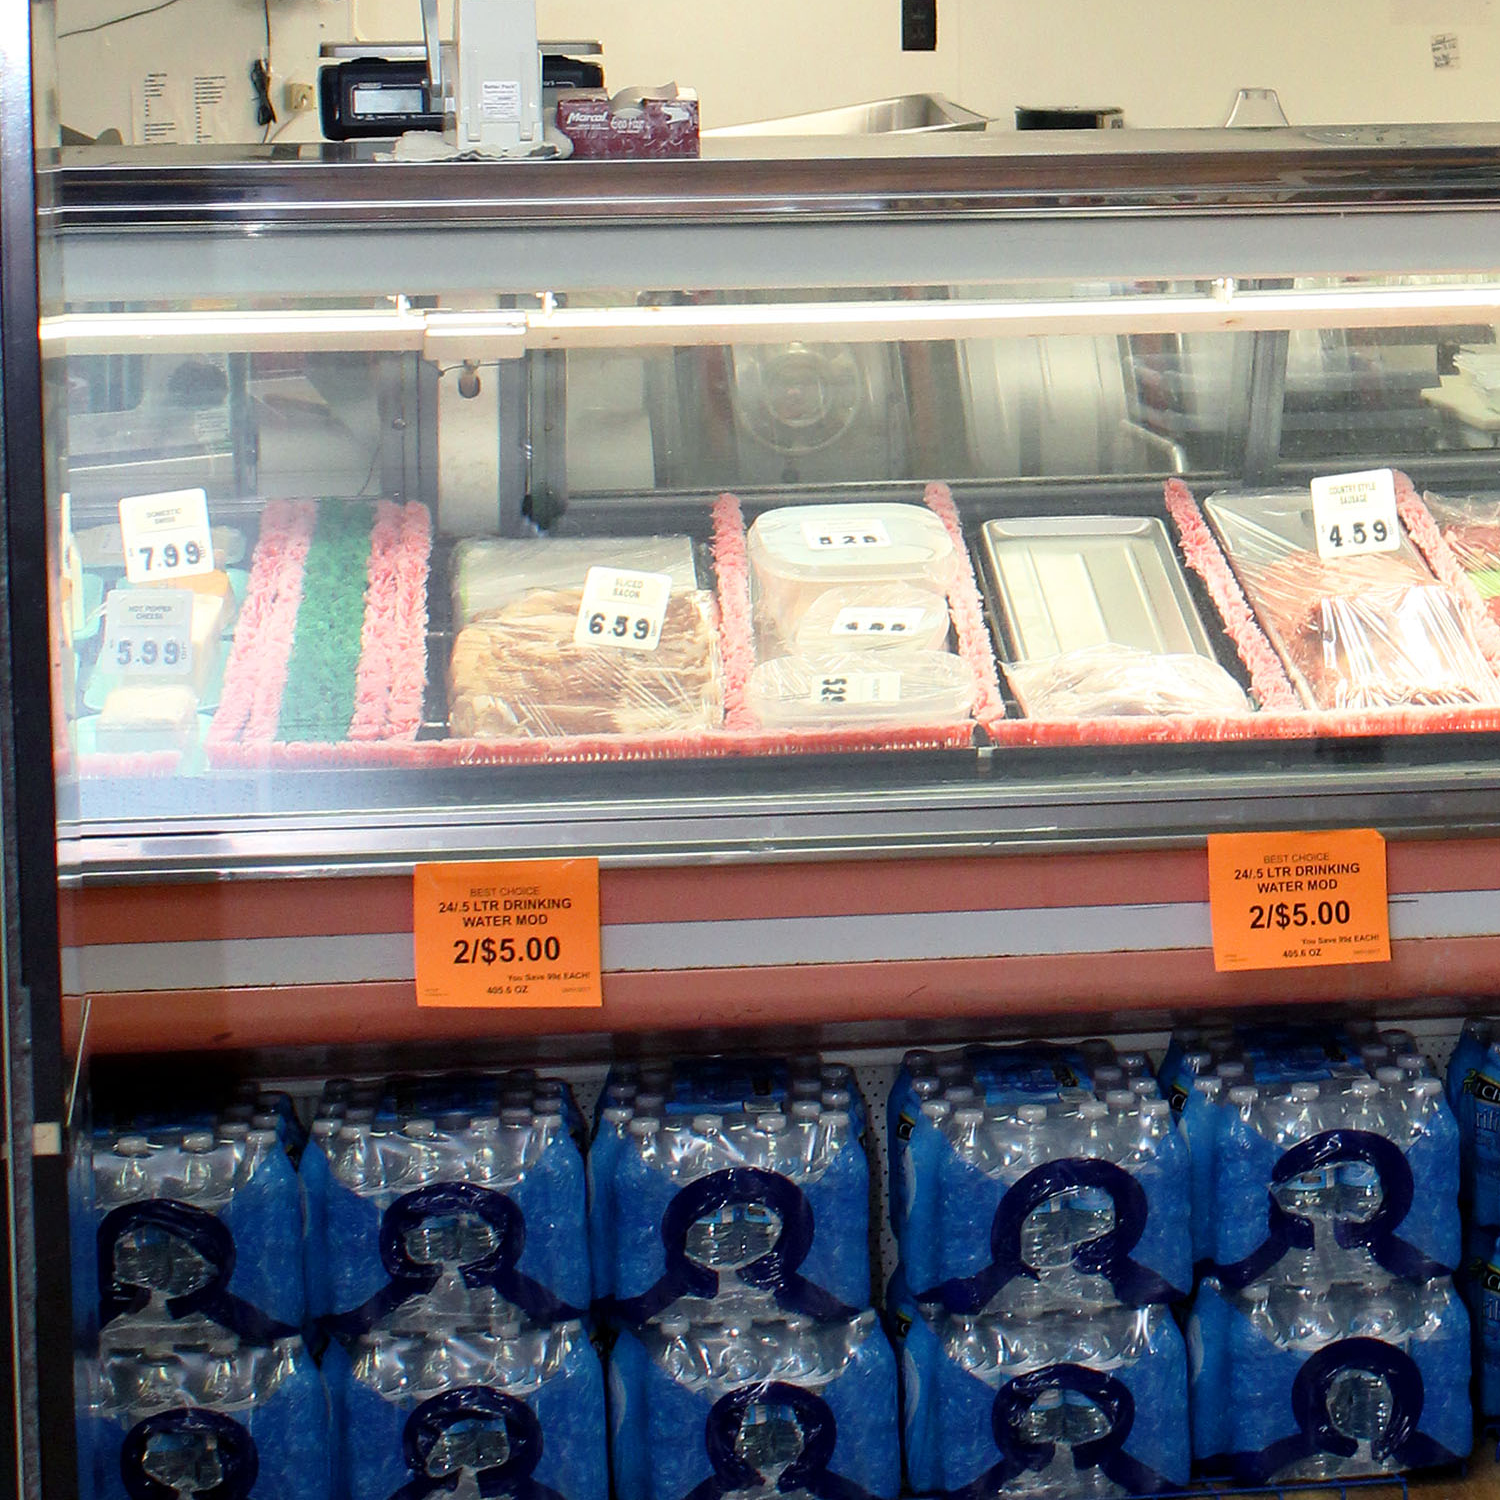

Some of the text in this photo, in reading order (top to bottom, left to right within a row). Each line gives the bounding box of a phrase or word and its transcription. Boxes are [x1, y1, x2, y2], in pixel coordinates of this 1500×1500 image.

[1329, 519, 1388, 547] 4.59
[139, 540, 200, 571] 7.99
[589, 612, 650, 640] 6.59
[117, 639, 179, 665] 5.99
[1264, 853, 1329, 864] BEST CHOICE
[1267, 866, 1291, 878] LTR
[1295, 863, 1360, 877] DRINKING
[470, 886, 540, 897] BEST CHOICE
[1257, 879, 1338, 894] WATER MOD
[474, 900, 500, 912] LTR
[503, 898, 572, 911] DRINKING
[463, 914, 548, 928] WATER MOD
[1249, 900, 1351, 930] 2/$5.00
[453, 936, 561, 966] 2/$5.00
[1309, 949, 1322, 957] OZ
[514, 986, 528, 994] OZ
